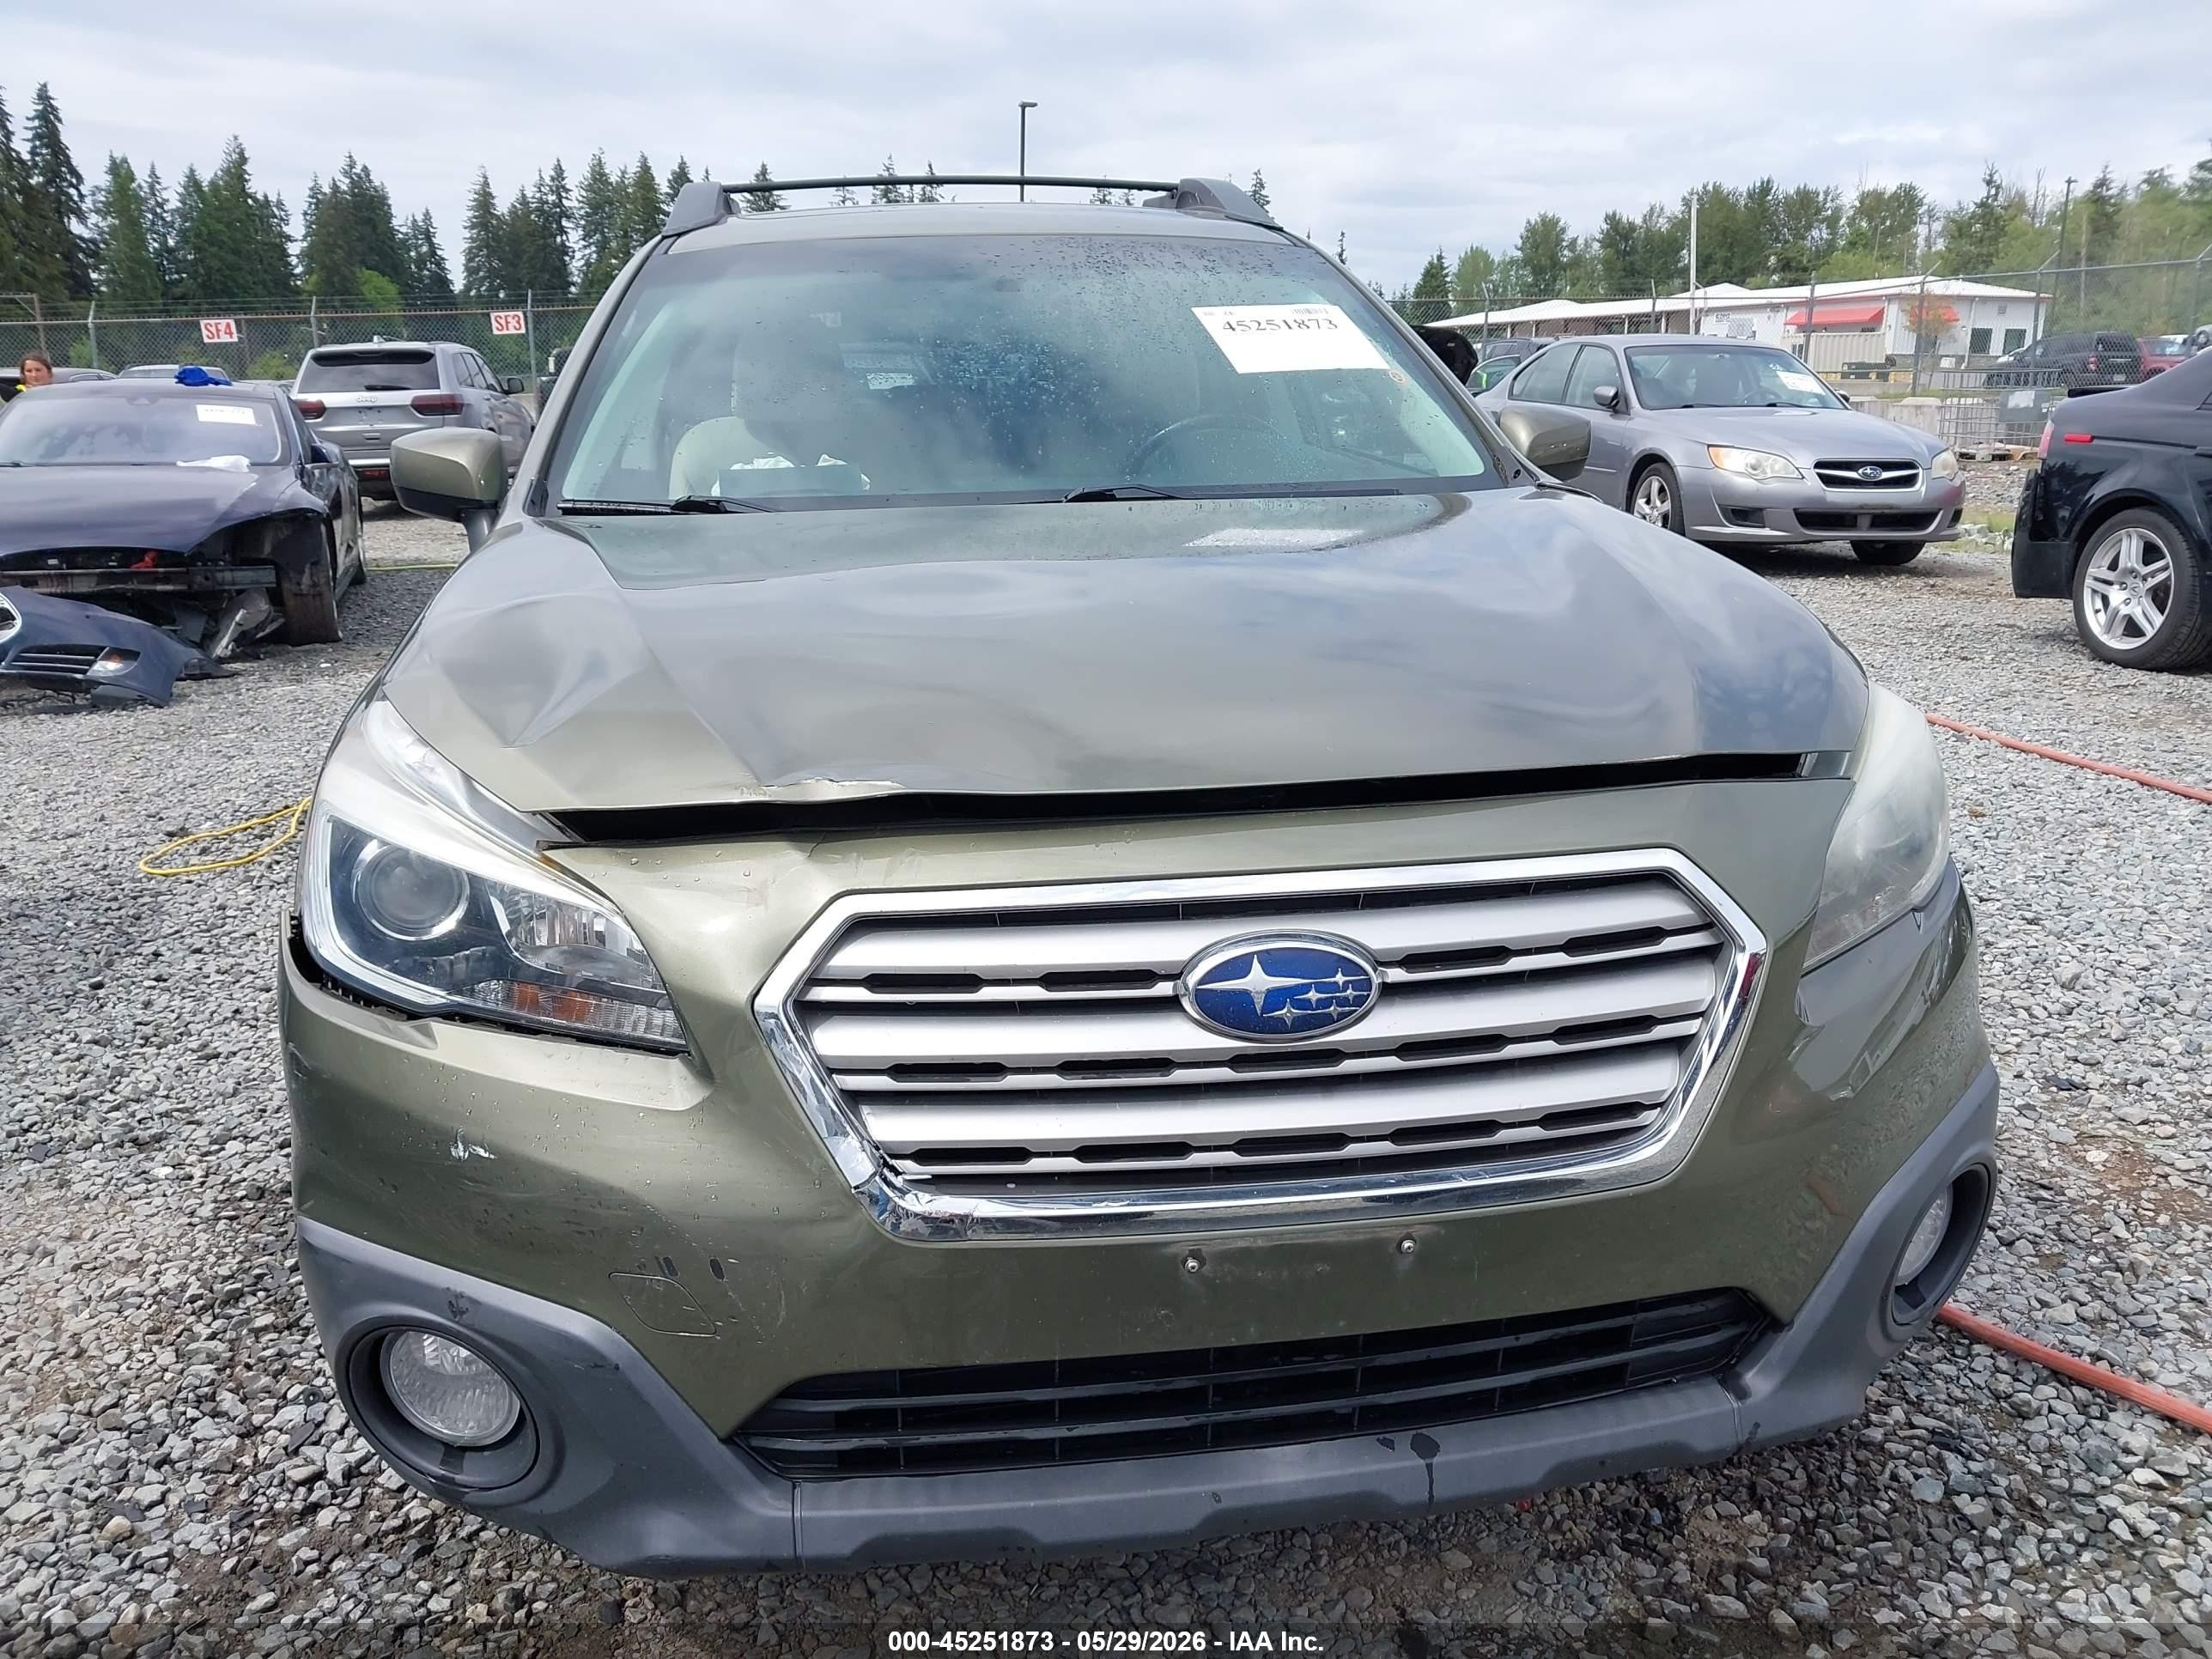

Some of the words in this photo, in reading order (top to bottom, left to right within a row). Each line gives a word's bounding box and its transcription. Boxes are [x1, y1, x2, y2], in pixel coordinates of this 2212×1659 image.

[204, 322, 234, 340] SF4
[494, 314, 522, 331] SF3
[1223, 319, 1338, 332] 45251873
